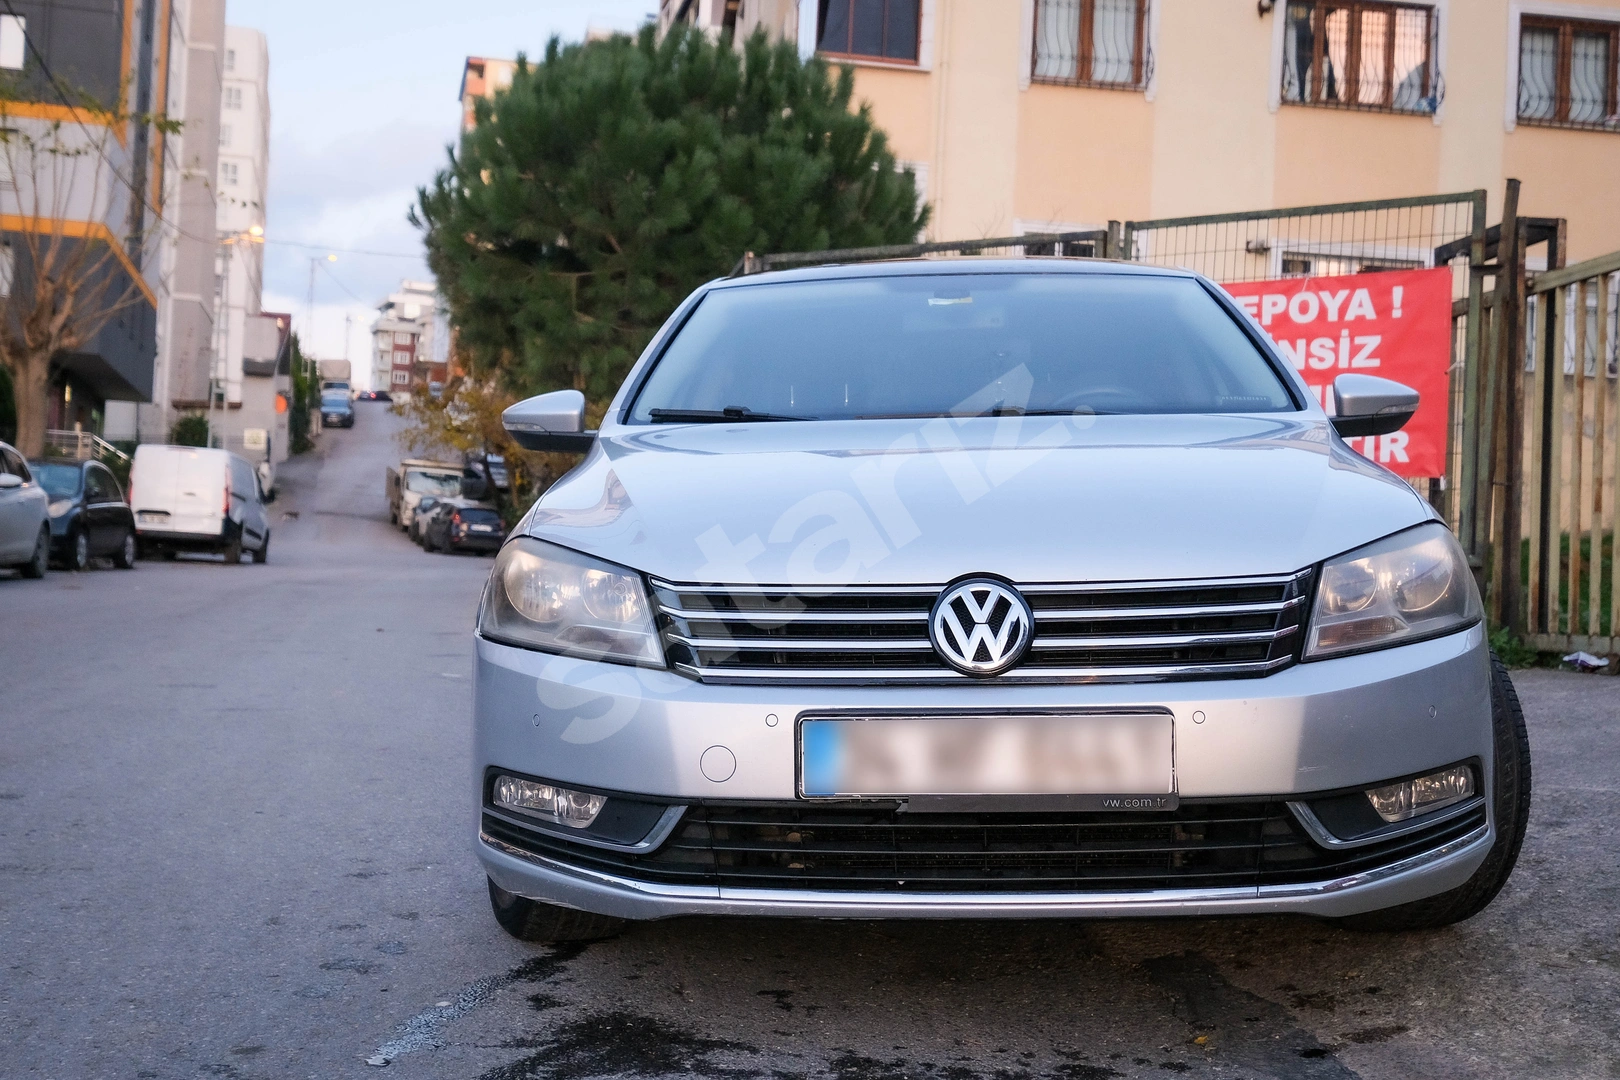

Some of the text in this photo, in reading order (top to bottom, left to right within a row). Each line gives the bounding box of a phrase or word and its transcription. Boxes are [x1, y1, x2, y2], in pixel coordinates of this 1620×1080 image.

[1392, 286, 1404, 318] !
[1269, 329, 1382, 370] NSİZ
[1102, 797, 1167, 808] vw.com.tr
